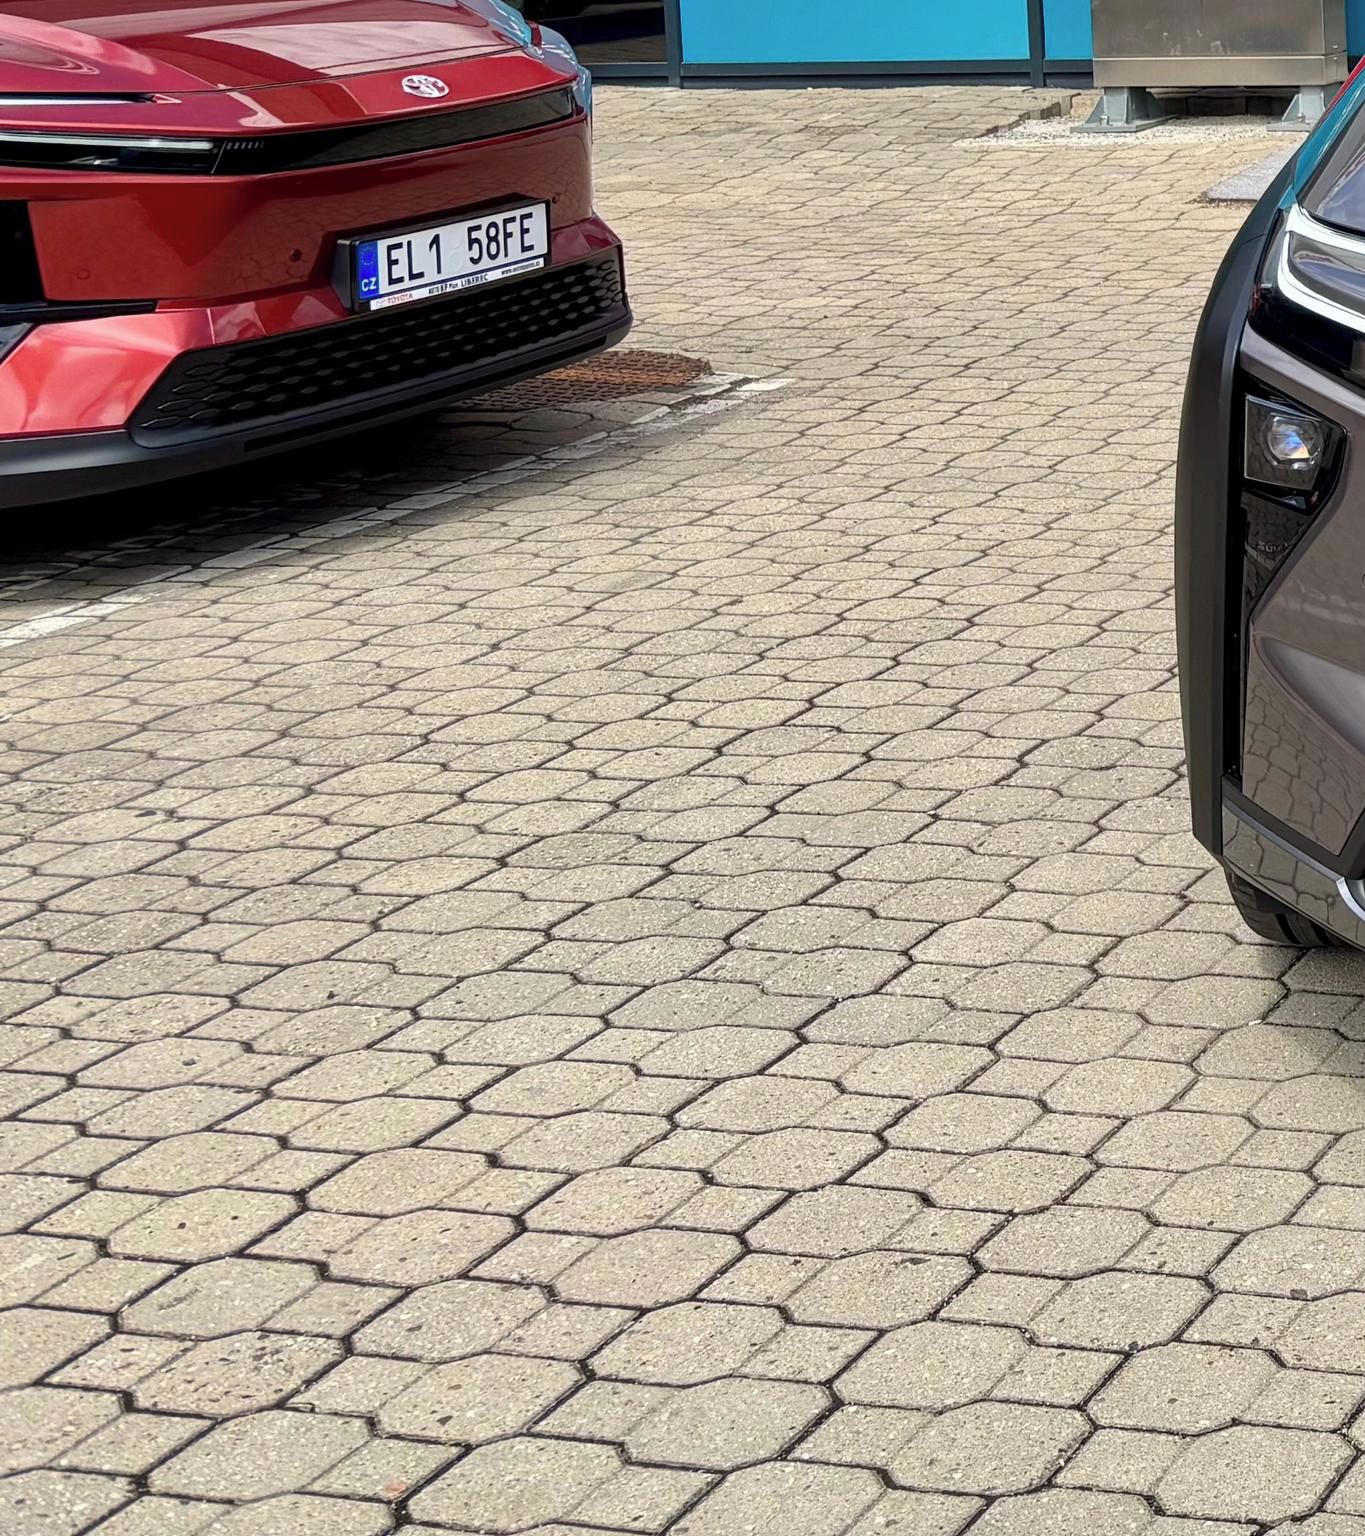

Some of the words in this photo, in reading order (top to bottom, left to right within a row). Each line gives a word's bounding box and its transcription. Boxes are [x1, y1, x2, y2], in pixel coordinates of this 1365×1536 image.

[386, 233, 442, 286] EL1
[467, 212, 535, 265] 58FE
[361, 276, 377, 293] CZ
